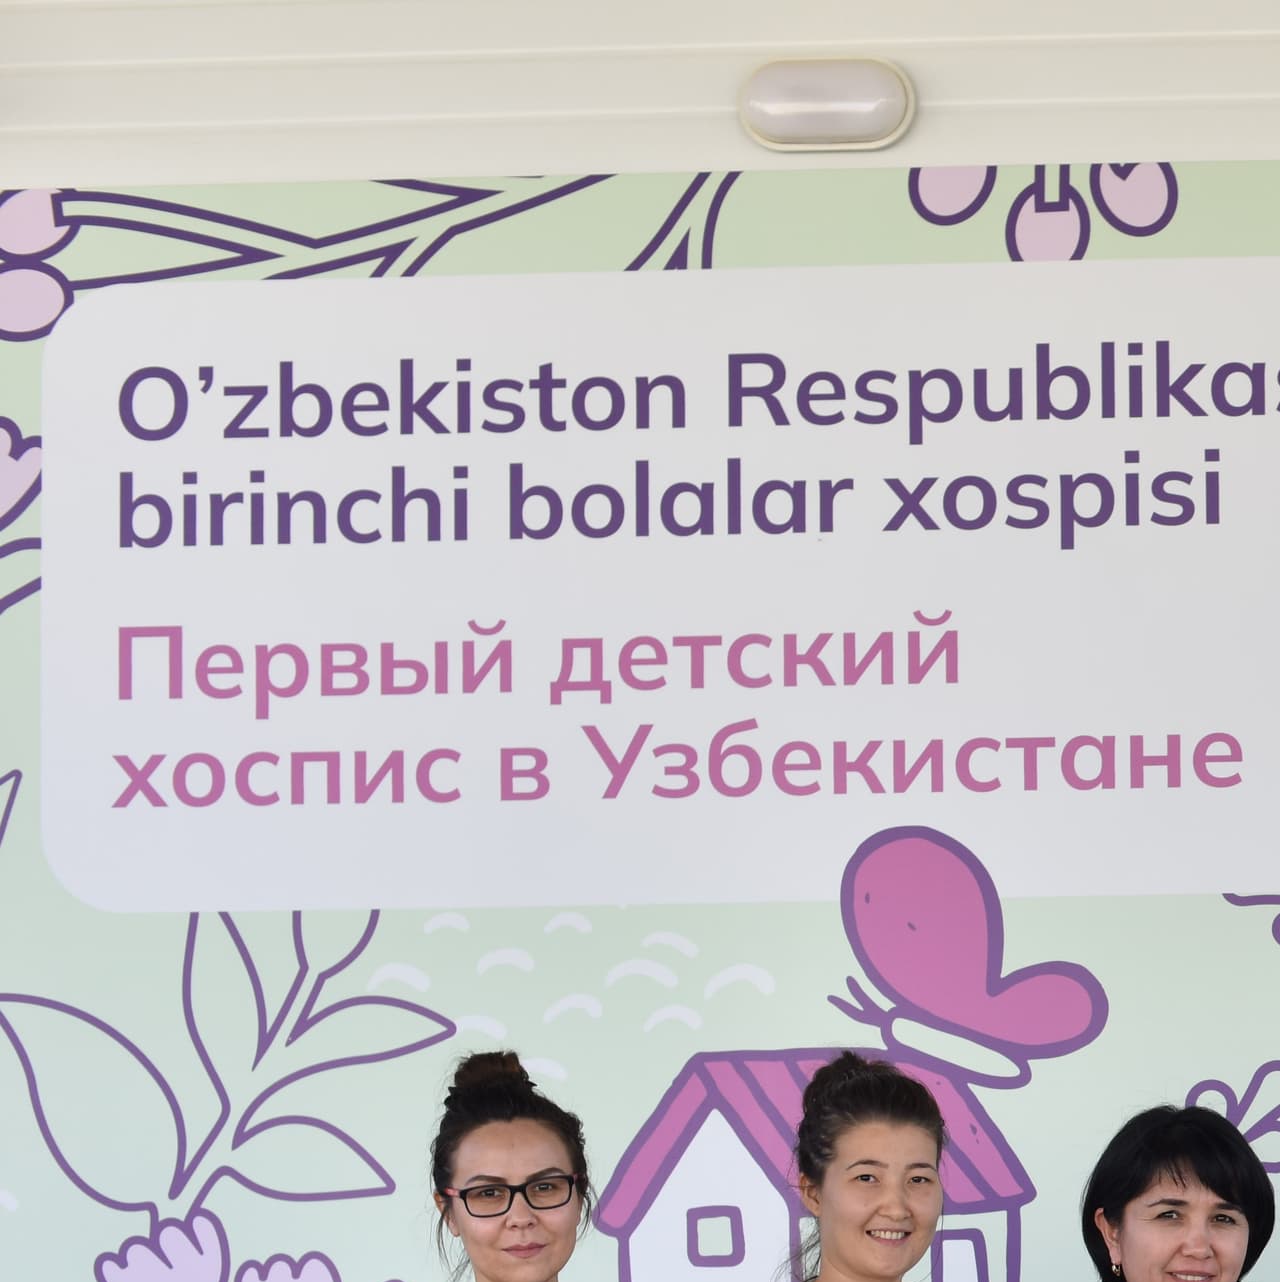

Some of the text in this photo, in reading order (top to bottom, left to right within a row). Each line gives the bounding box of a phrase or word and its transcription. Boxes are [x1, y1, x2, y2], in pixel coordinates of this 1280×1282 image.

[119, 360, 686, 441] O’zbekiston
[121, 449, 1220, 549] birinchi bolalar xospisi
[119, 611, 958, 719] Первый детский
[114, 719, 1242, 808] хоспис в Узбекистане
